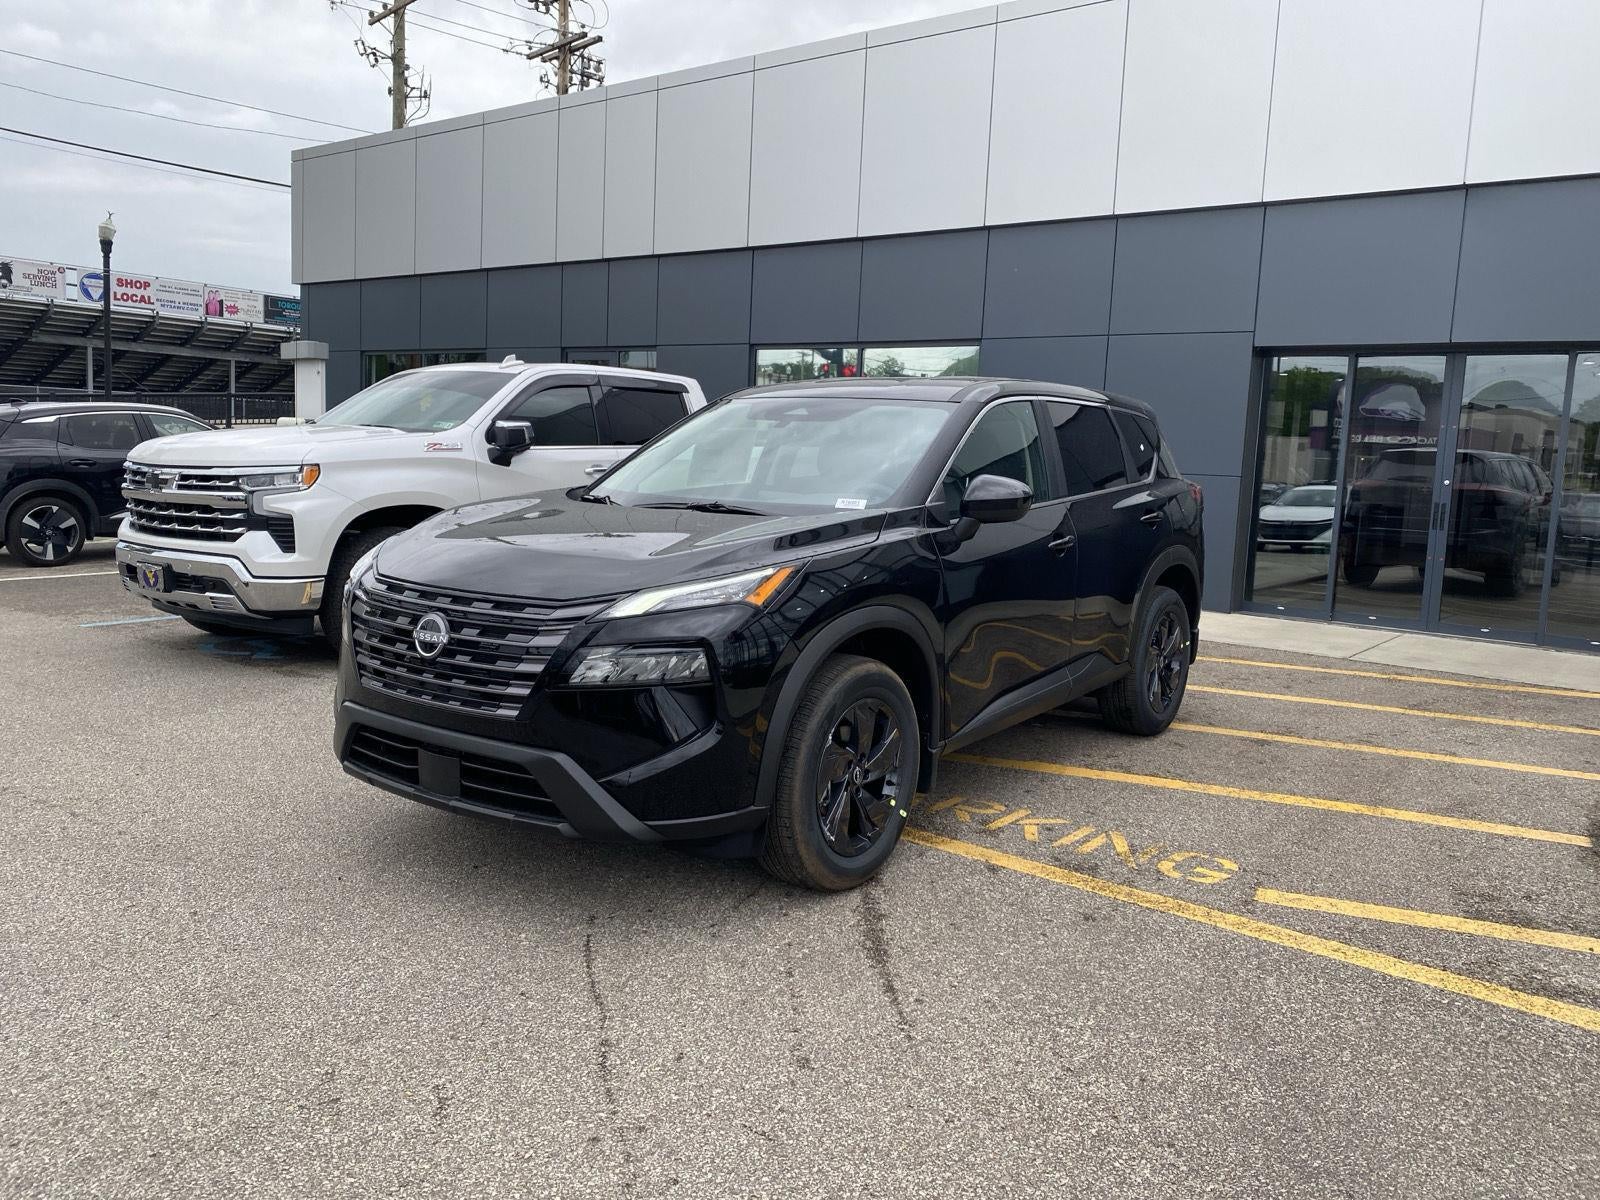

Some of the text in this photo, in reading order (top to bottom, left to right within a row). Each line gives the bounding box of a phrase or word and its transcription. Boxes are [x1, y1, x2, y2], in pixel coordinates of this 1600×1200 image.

[37, 268, 57, 276] NOW
[22, 273, 57, 283] SERVING
[116, 277, 151, 290] SHOP
[30, 280, 57, 288] LUNCH
[113, 292, 155, 305] LOCAL
[412, 630, 447, 642] NISSAN
